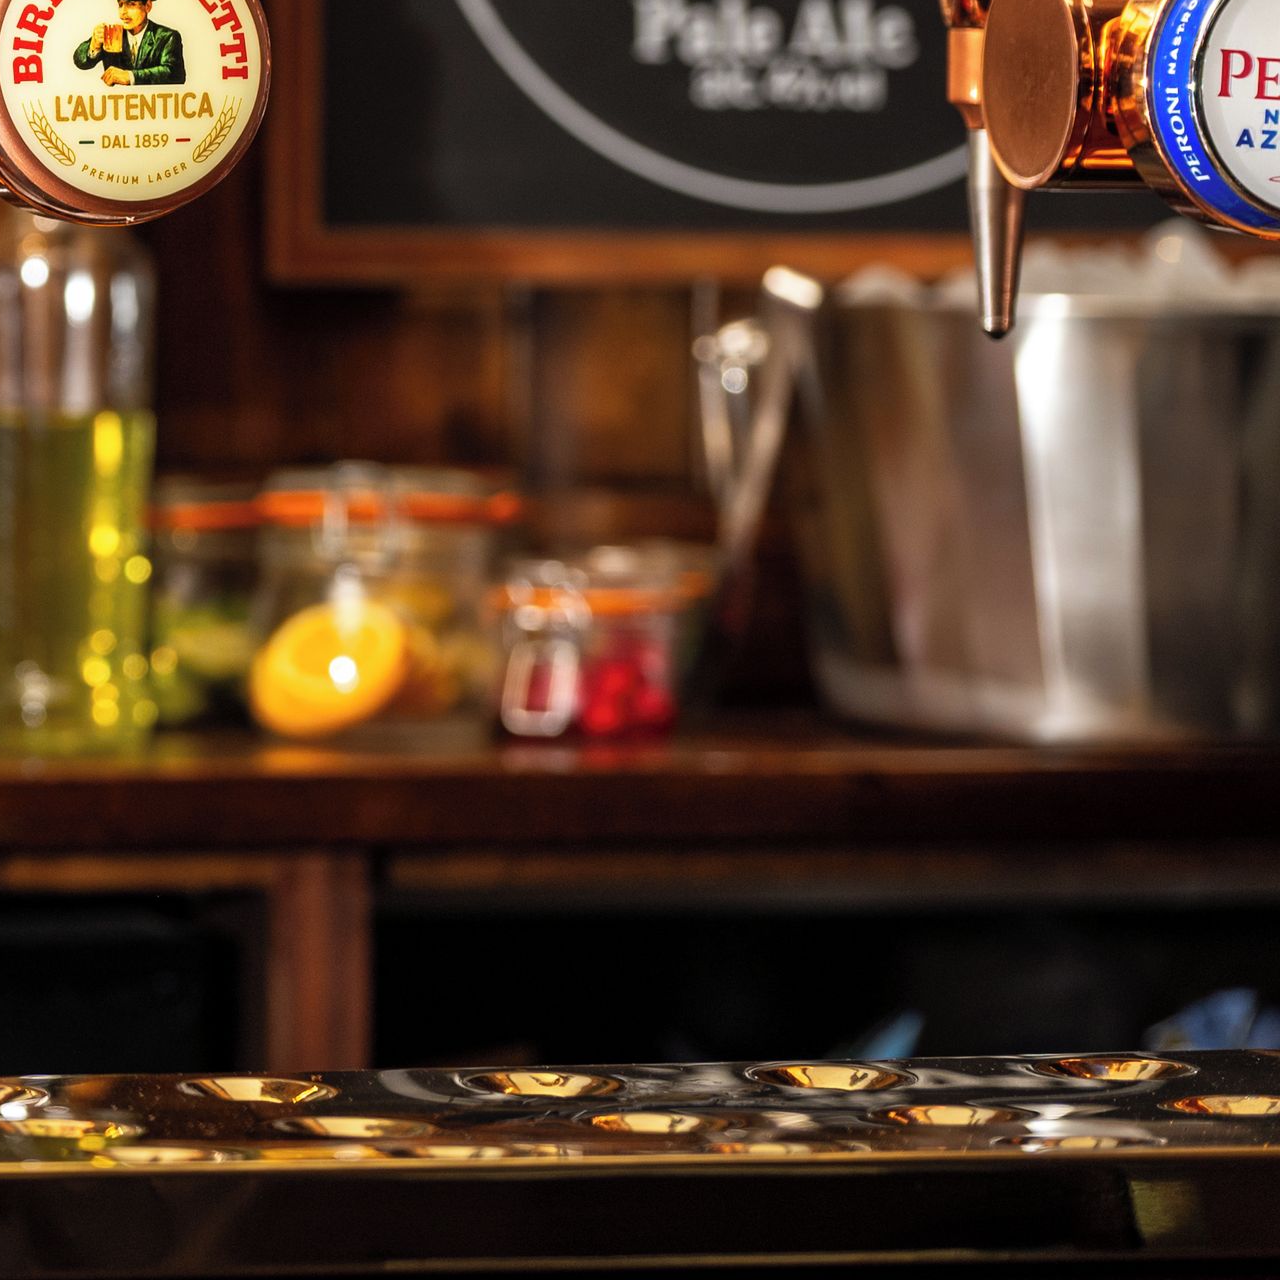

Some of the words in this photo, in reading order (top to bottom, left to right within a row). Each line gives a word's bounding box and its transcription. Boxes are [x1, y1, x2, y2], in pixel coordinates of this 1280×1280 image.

[1167, 0, 1199, 75] NASTRO
[1217, 48, 1280, 100] PE
[55, 91, 214, 122] L'AUTENTICA
[101, 134, 130, 149] DAL
[134, 133, 169, 148] 1859
[1166, 87, 1211, 182] PERONI
[1235, 128, 1278, 150] AZ
[81, 163, 140, 185] PREMIUM
[148, 162, 189, 184] LAGER
